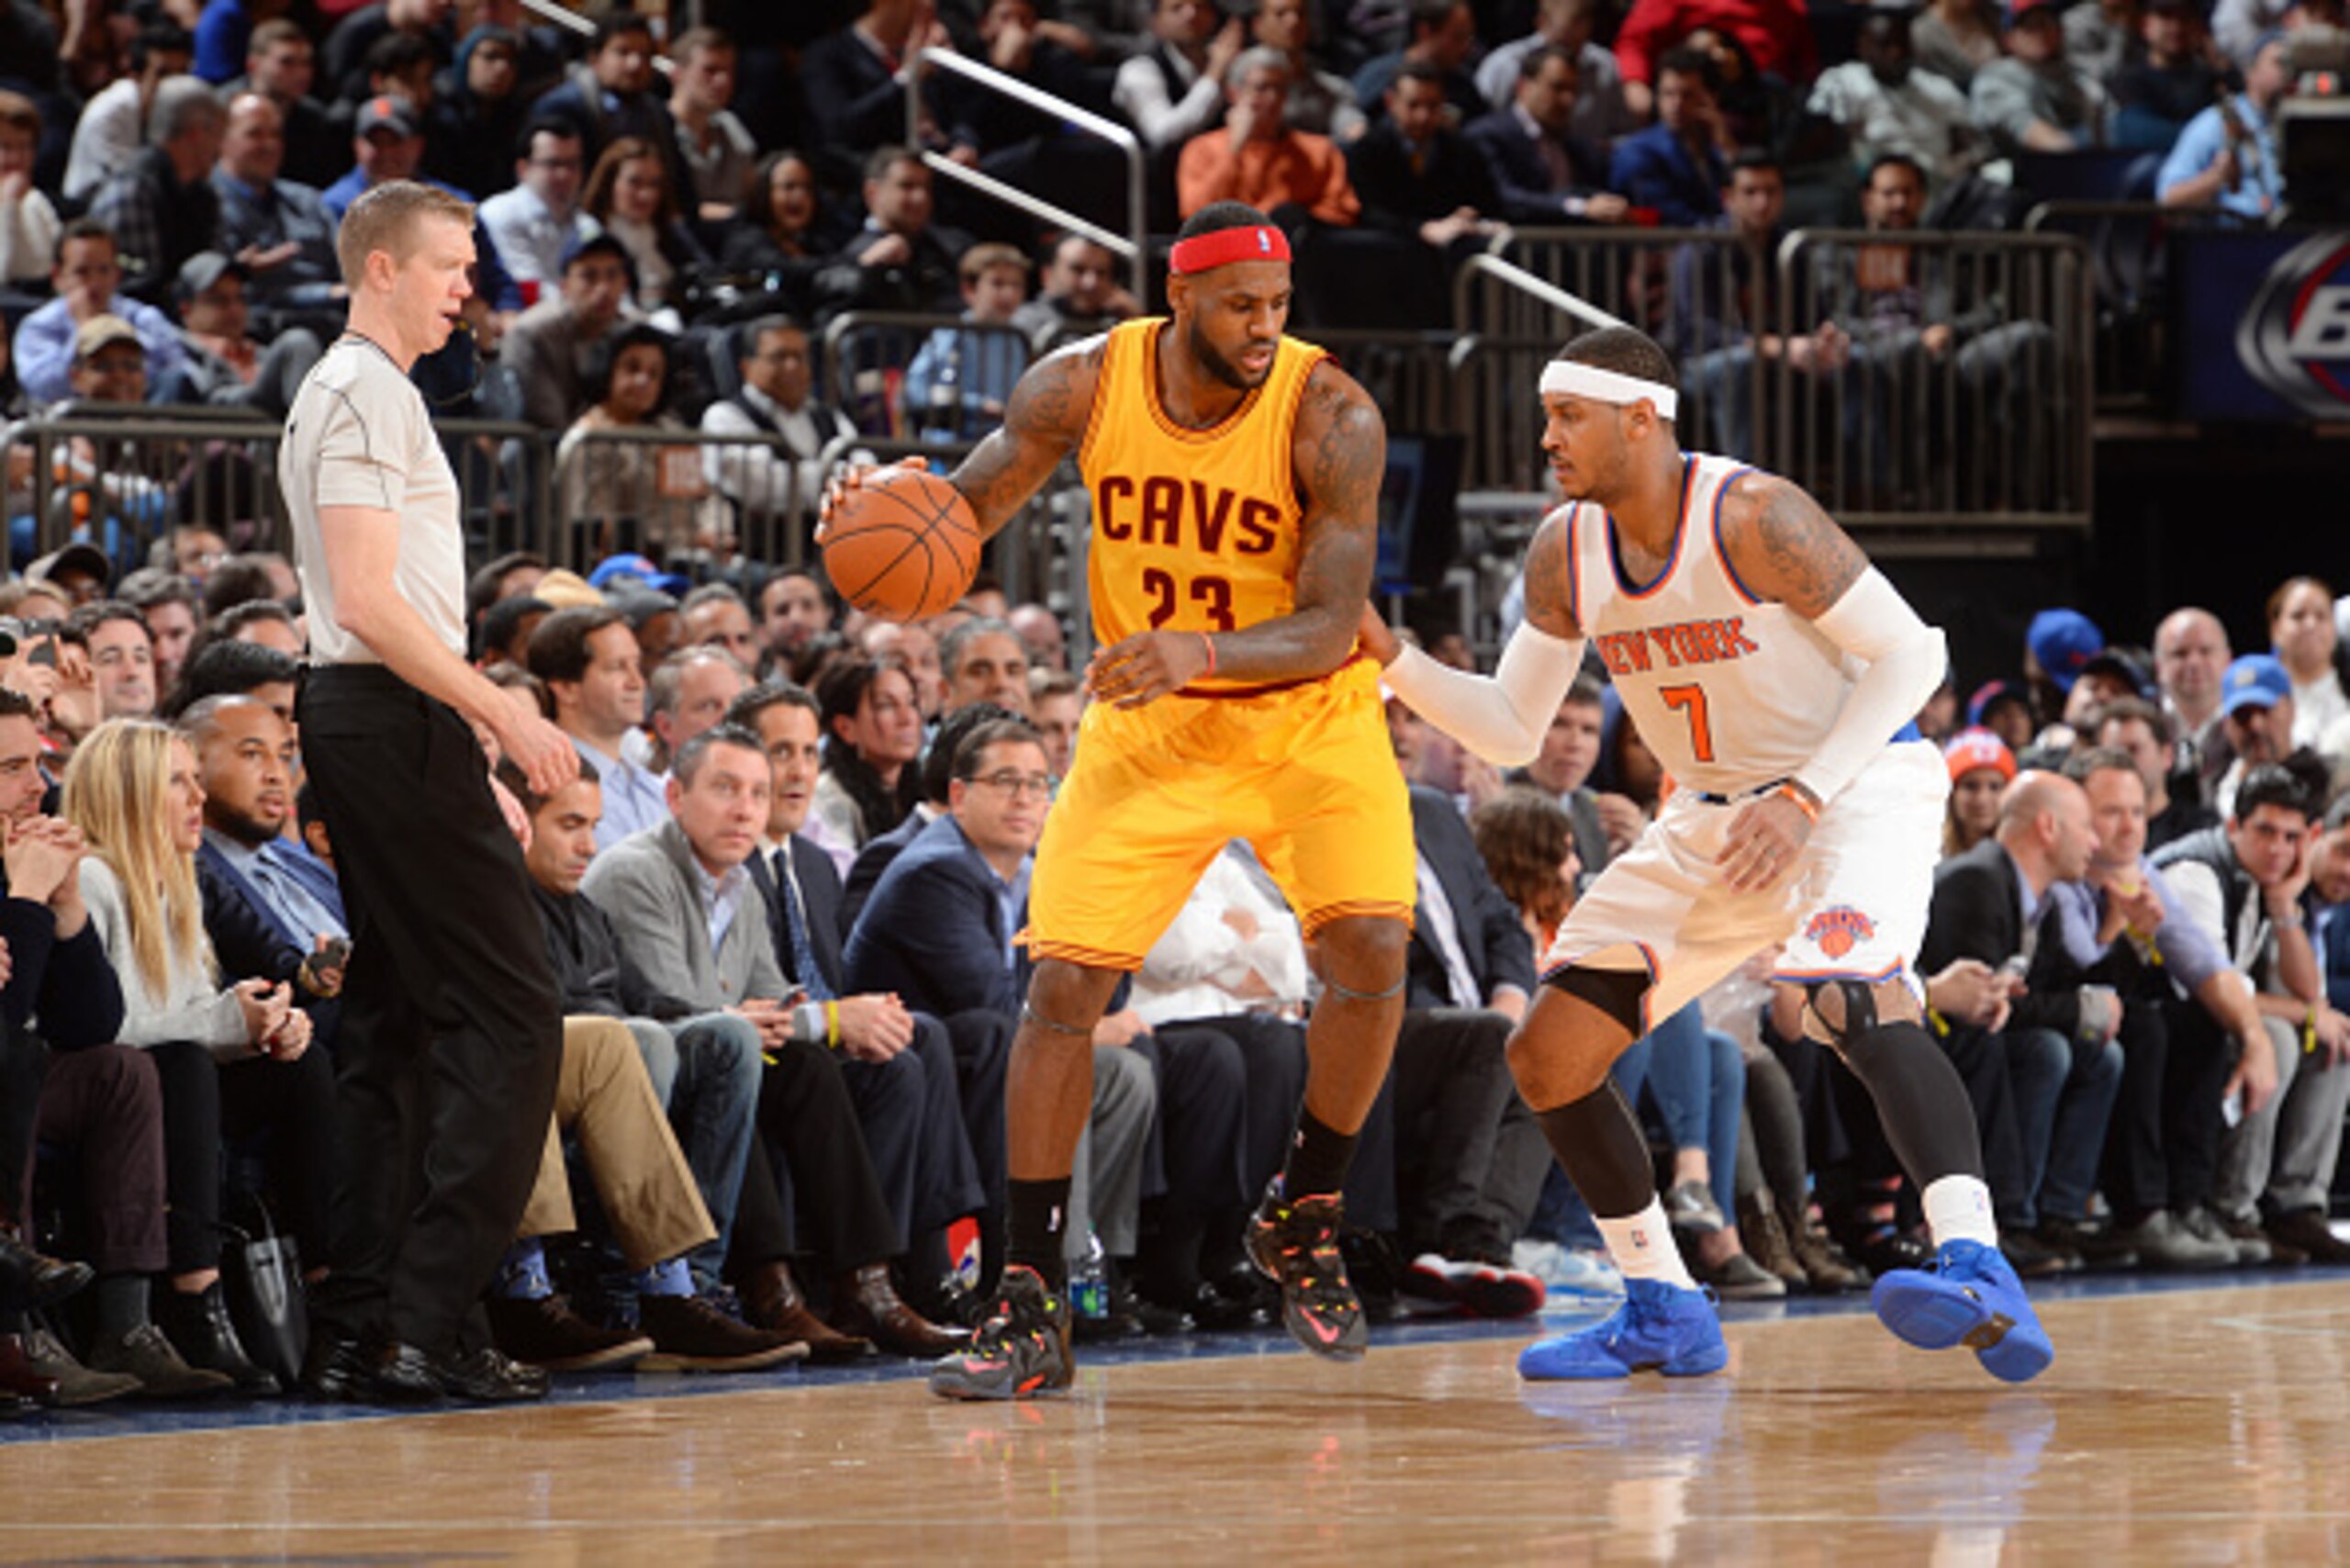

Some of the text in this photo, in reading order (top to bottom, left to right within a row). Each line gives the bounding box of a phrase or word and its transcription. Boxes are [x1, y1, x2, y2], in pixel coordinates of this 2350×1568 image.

[1099, 475, 1281, 555] CAVS
[1142, 566, 1236, 632] 23
[1648, 616, 1760, 667] YORK
[1659, 682, 1715, 763] 7
